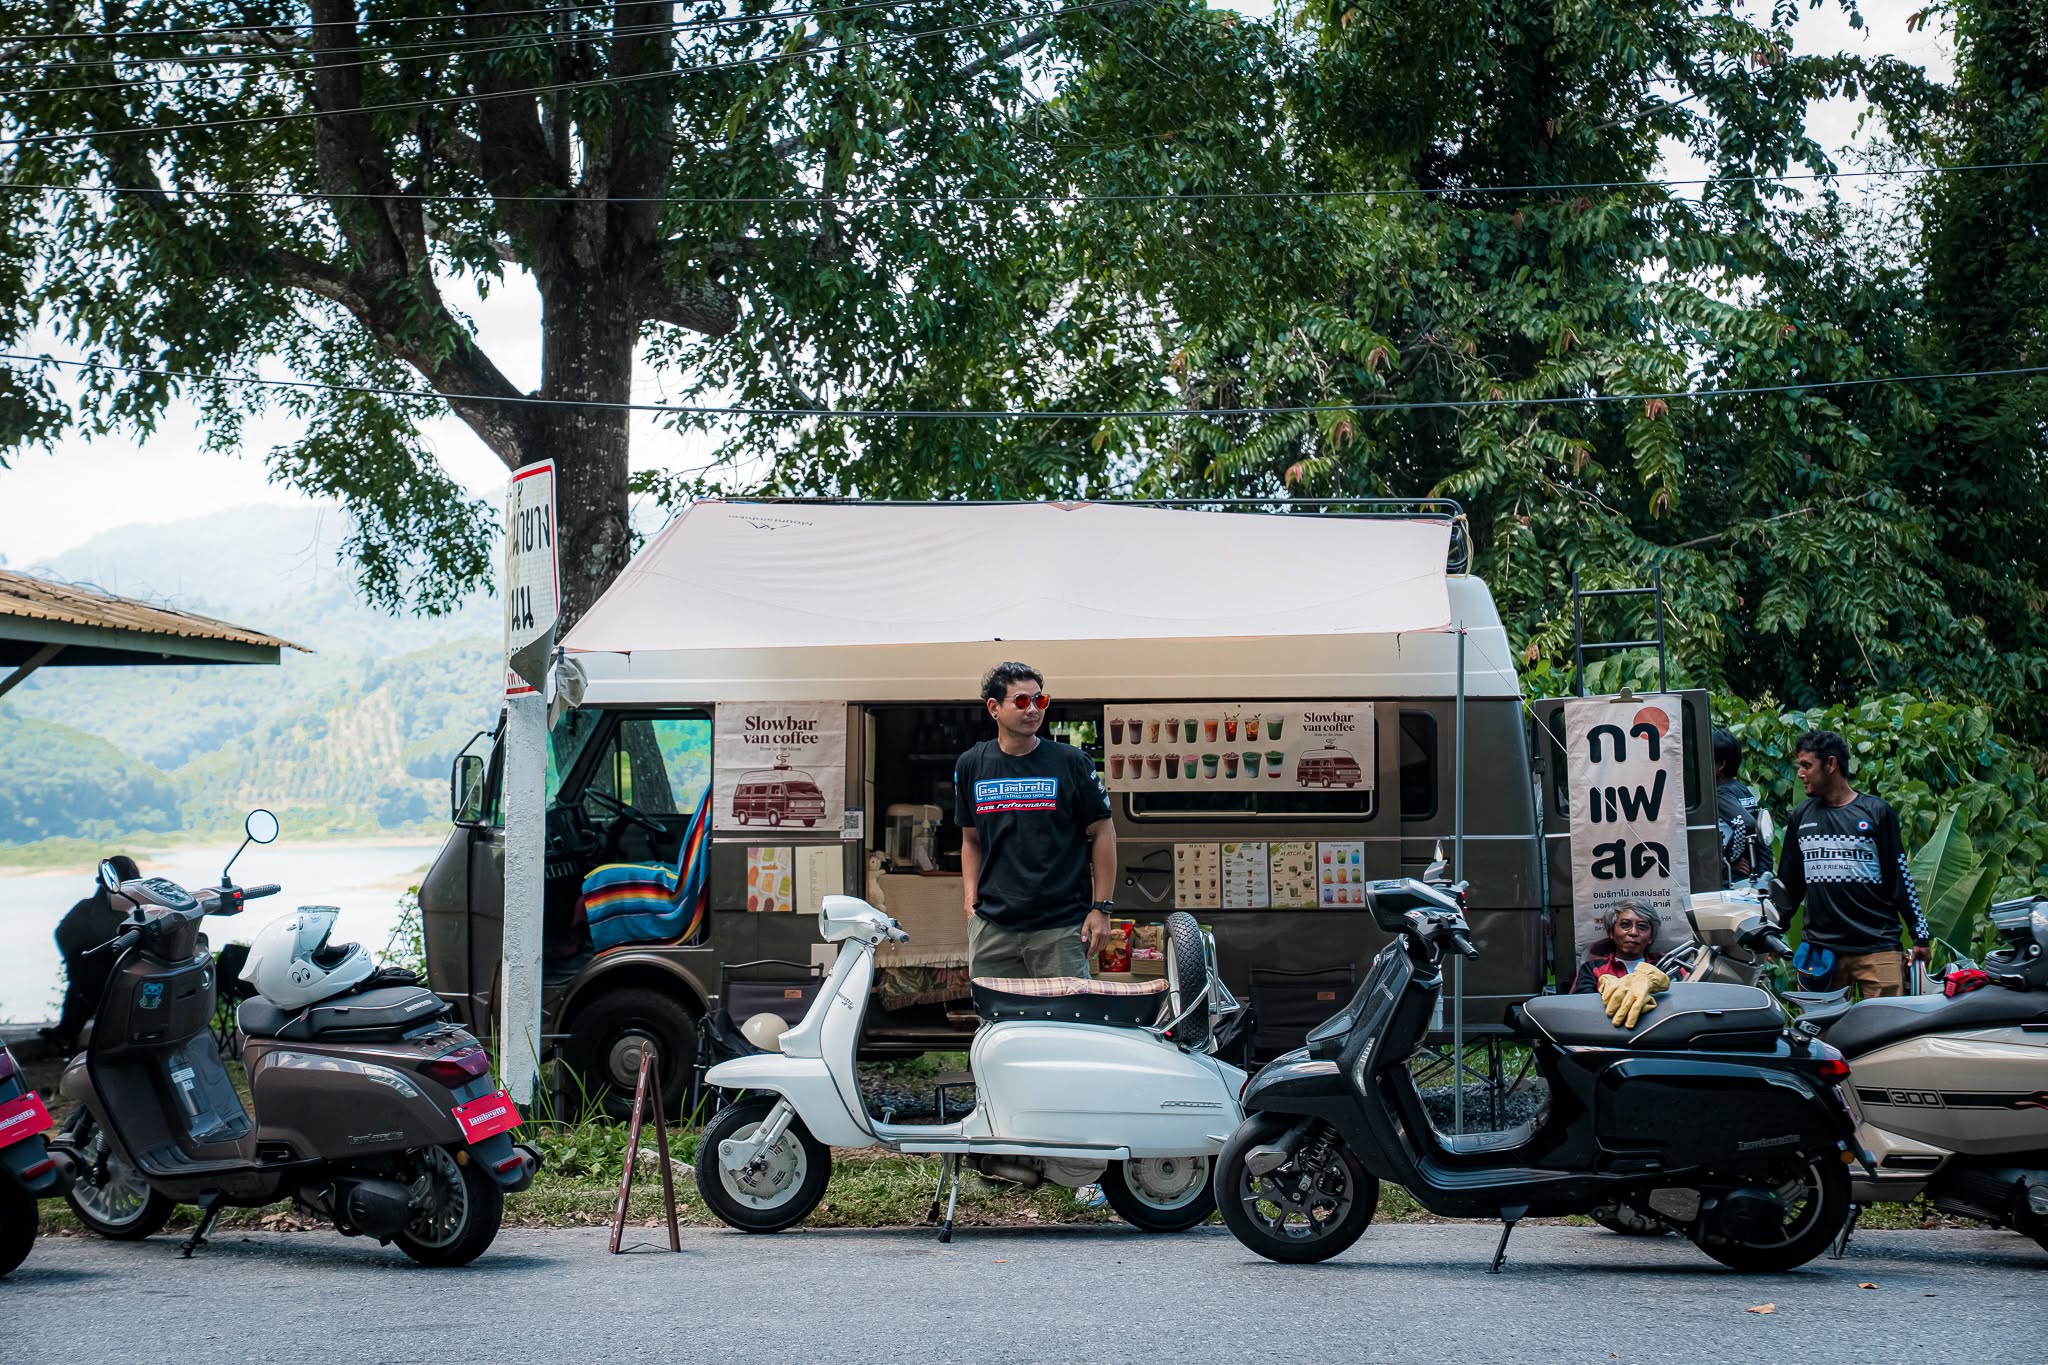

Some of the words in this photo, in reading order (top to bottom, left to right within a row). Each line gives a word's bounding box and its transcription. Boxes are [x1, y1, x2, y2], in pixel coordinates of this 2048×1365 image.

[745, 715, 817, 731] Slowbar
[1304, 712, 1354, 722] Slowbar
[1323, 722, 1355, 732] coffee
[743, 734, 770, 744] van
[772, 731, 818, 744] coffee
[1586, 723, 1660, 763] กา
[1589, 769, 1667, 824] แฟ
[1591, 839, 1670, 880] สด
[1803, 847, 1874, 862] mbretta
[1891, 1091, 1940, 1105] 300
